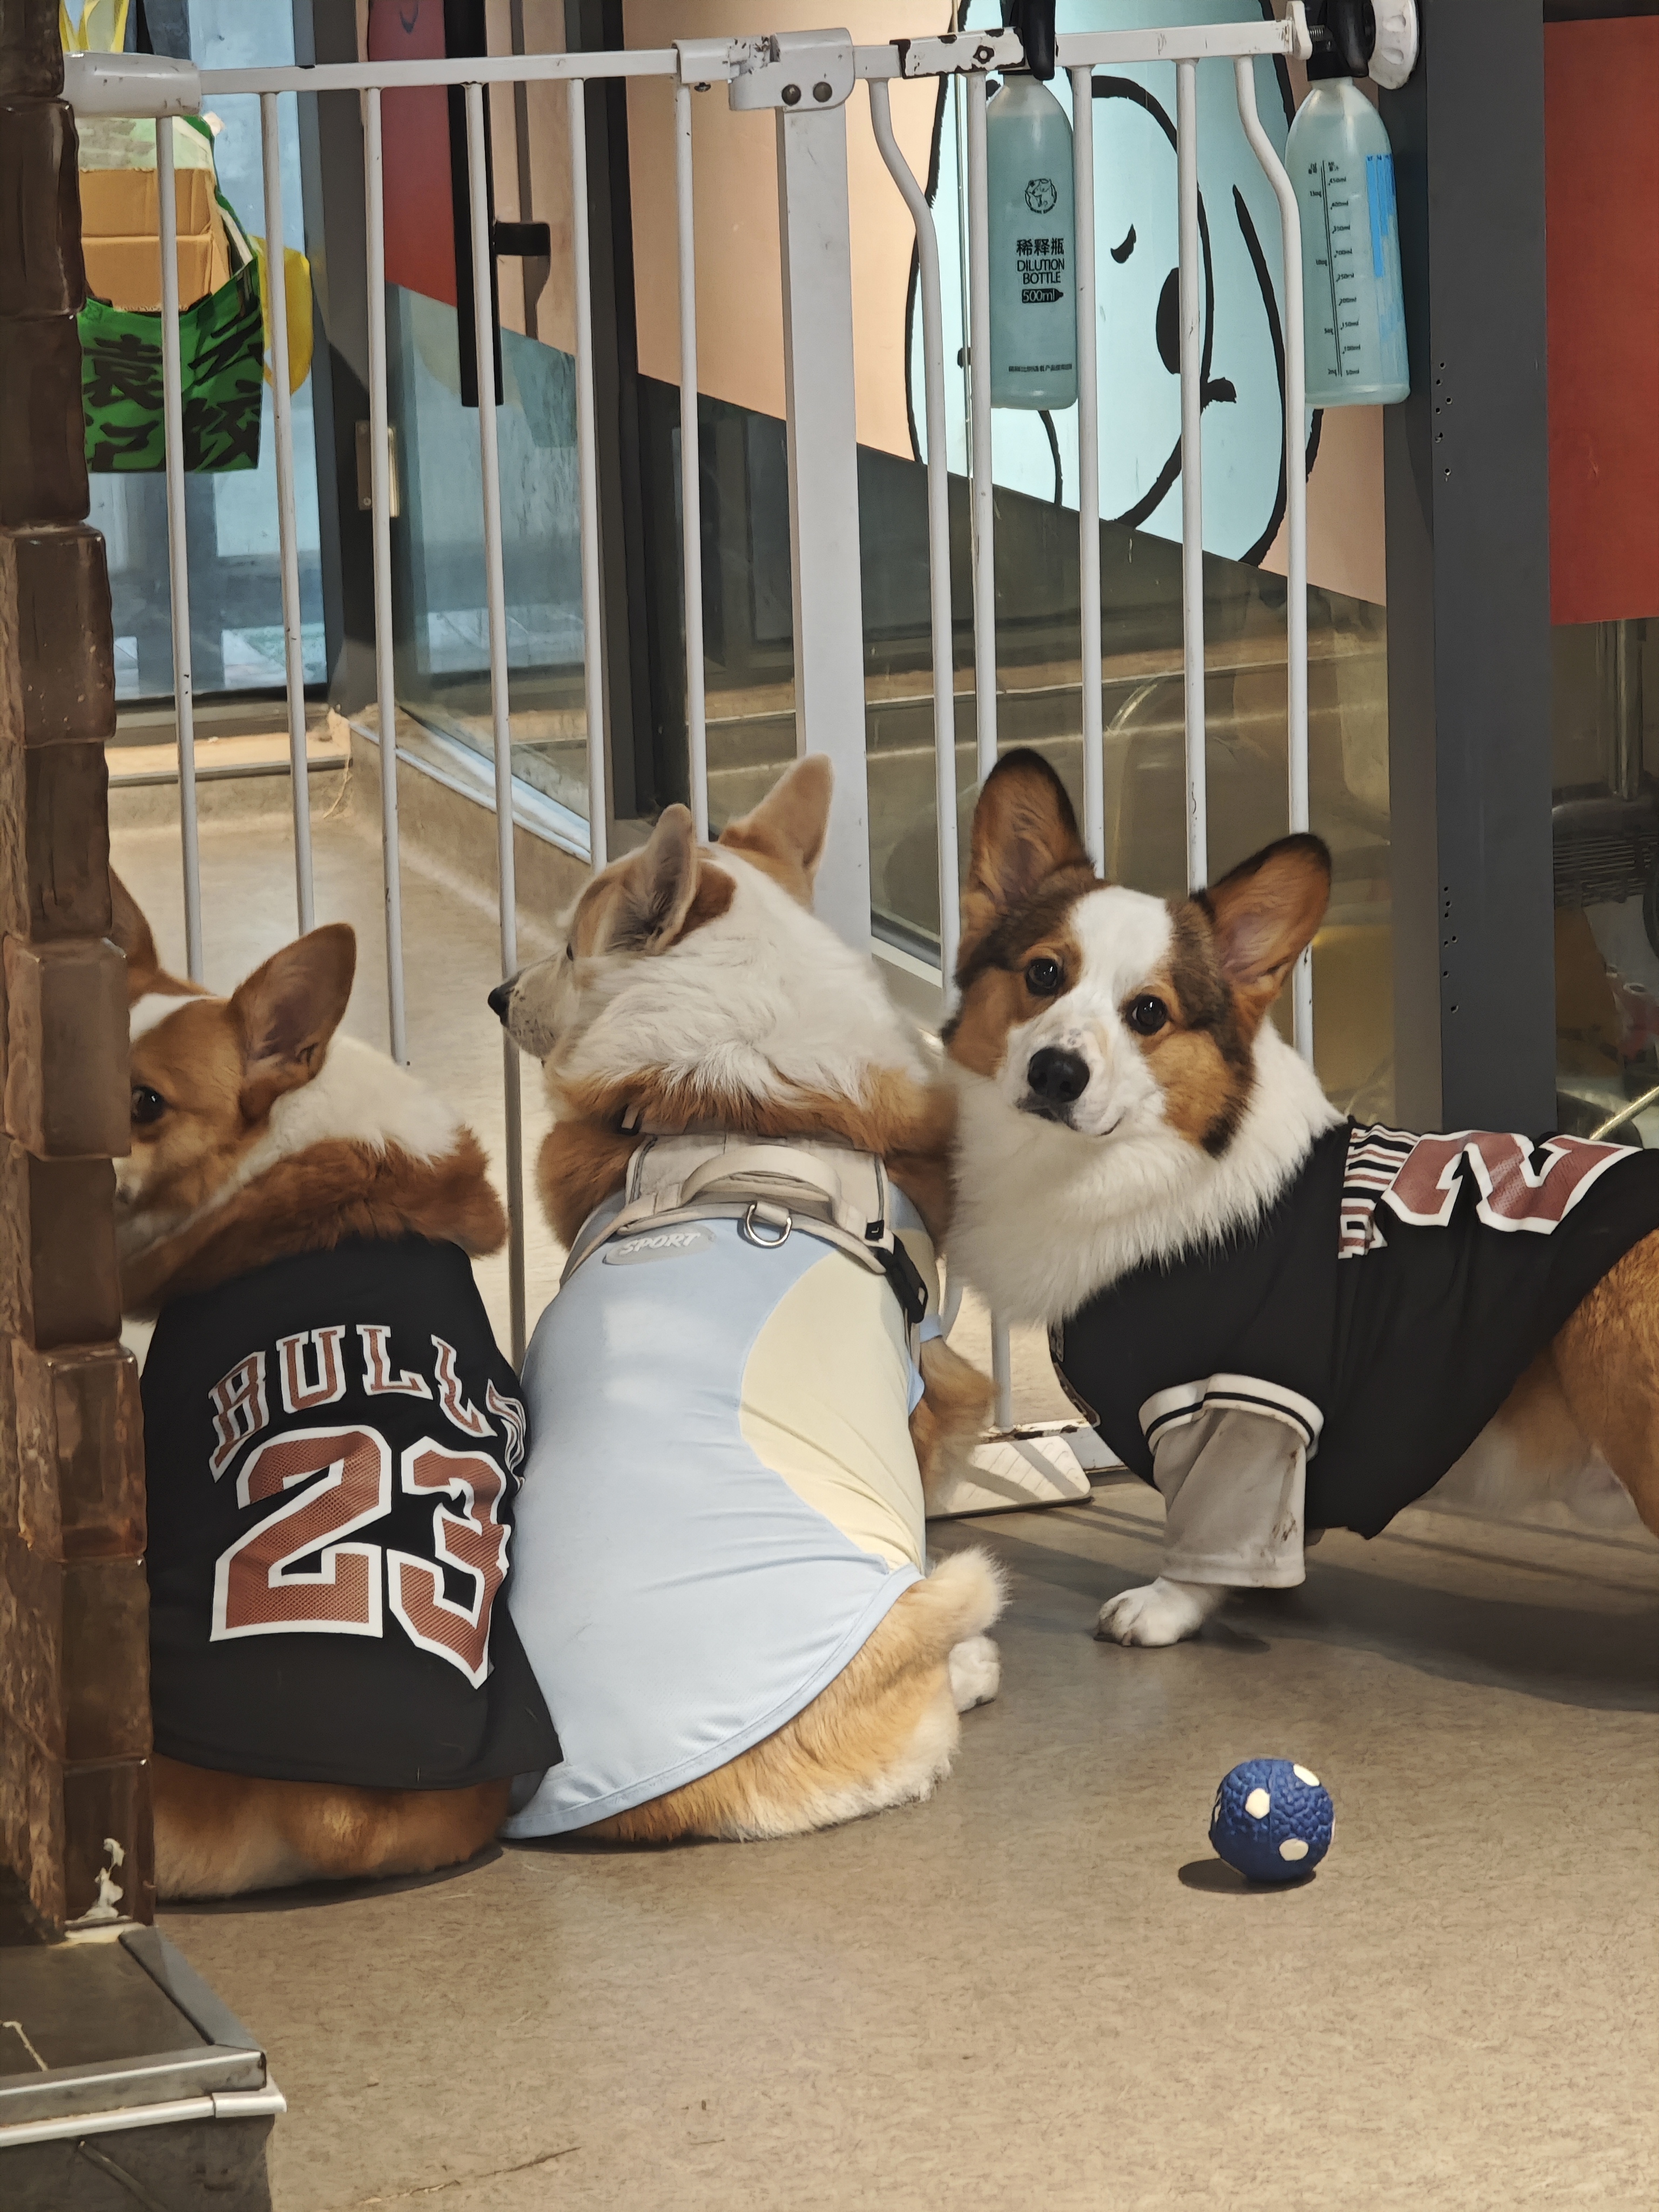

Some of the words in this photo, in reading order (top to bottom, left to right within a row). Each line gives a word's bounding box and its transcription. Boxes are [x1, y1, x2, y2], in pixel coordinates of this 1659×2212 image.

[1016, 238, 1064, 257] 稀释瓶
[1017, 258, 1065, 272] DILUTION
[1023, 272, 1061, 285] BOTTLE
[1023, 289, 1055, 302] 500ml
[618, 1232, 702, 1256] SPORT
[208, 1325, 527, 1494] BULLS
[210, 1424, 511, 1690] 23
